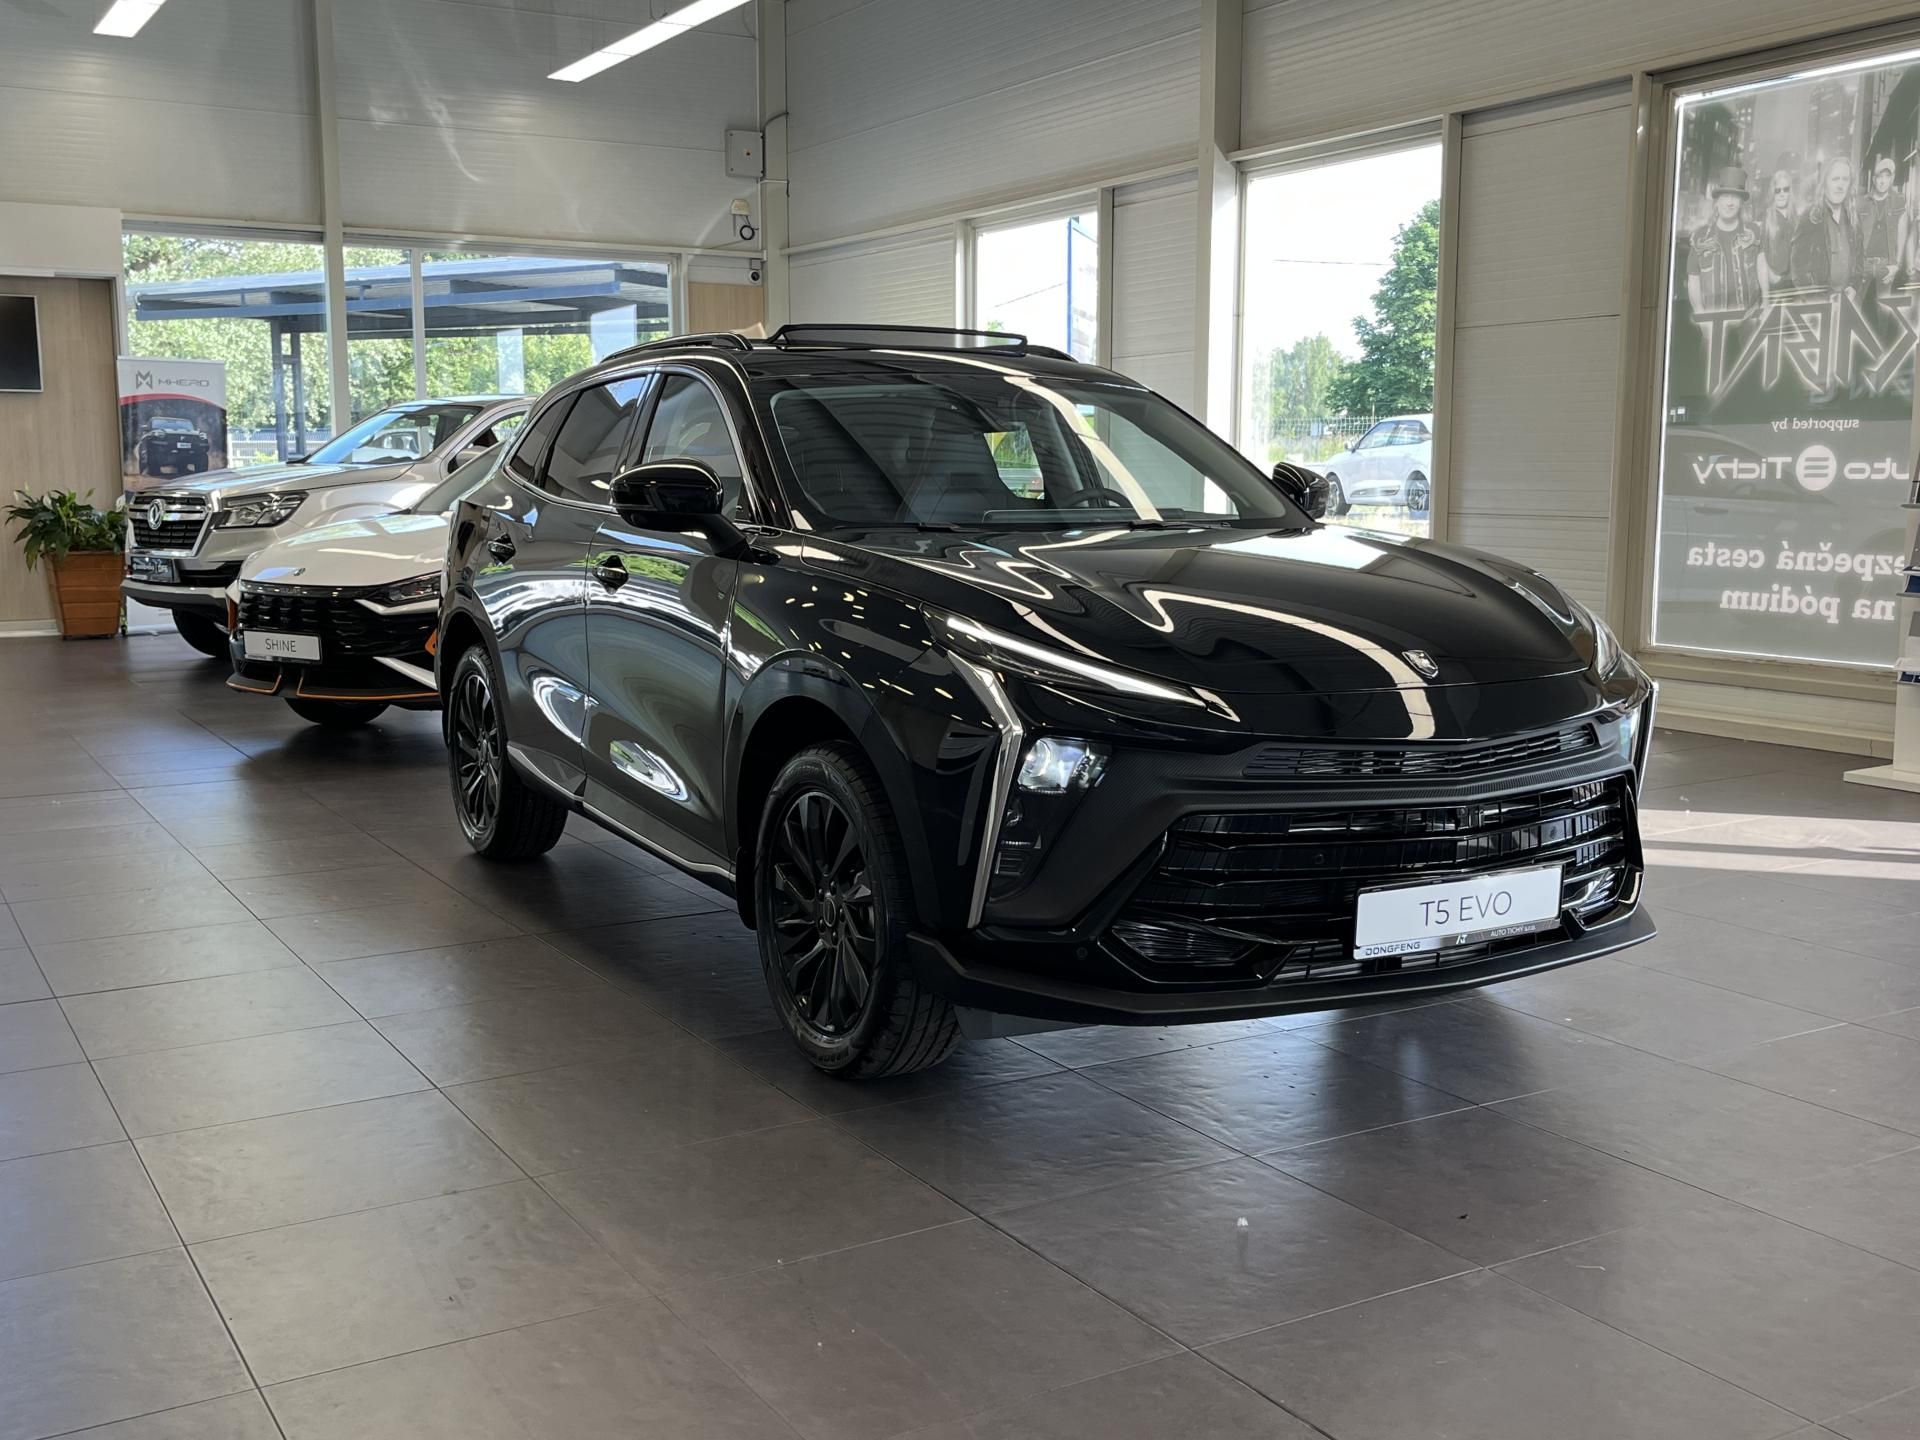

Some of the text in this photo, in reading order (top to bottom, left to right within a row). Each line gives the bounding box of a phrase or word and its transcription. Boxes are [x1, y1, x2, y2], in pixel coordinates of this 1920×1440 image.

[157, 378, 210, 388] MHERO
[265, 638, 297, 653] SHINE
[1419, 891, 1512, 927] T5 EVO
[1365, 942, 1420, 955] DONGFENG
[1490, 928, 1506, 937] AUTO
